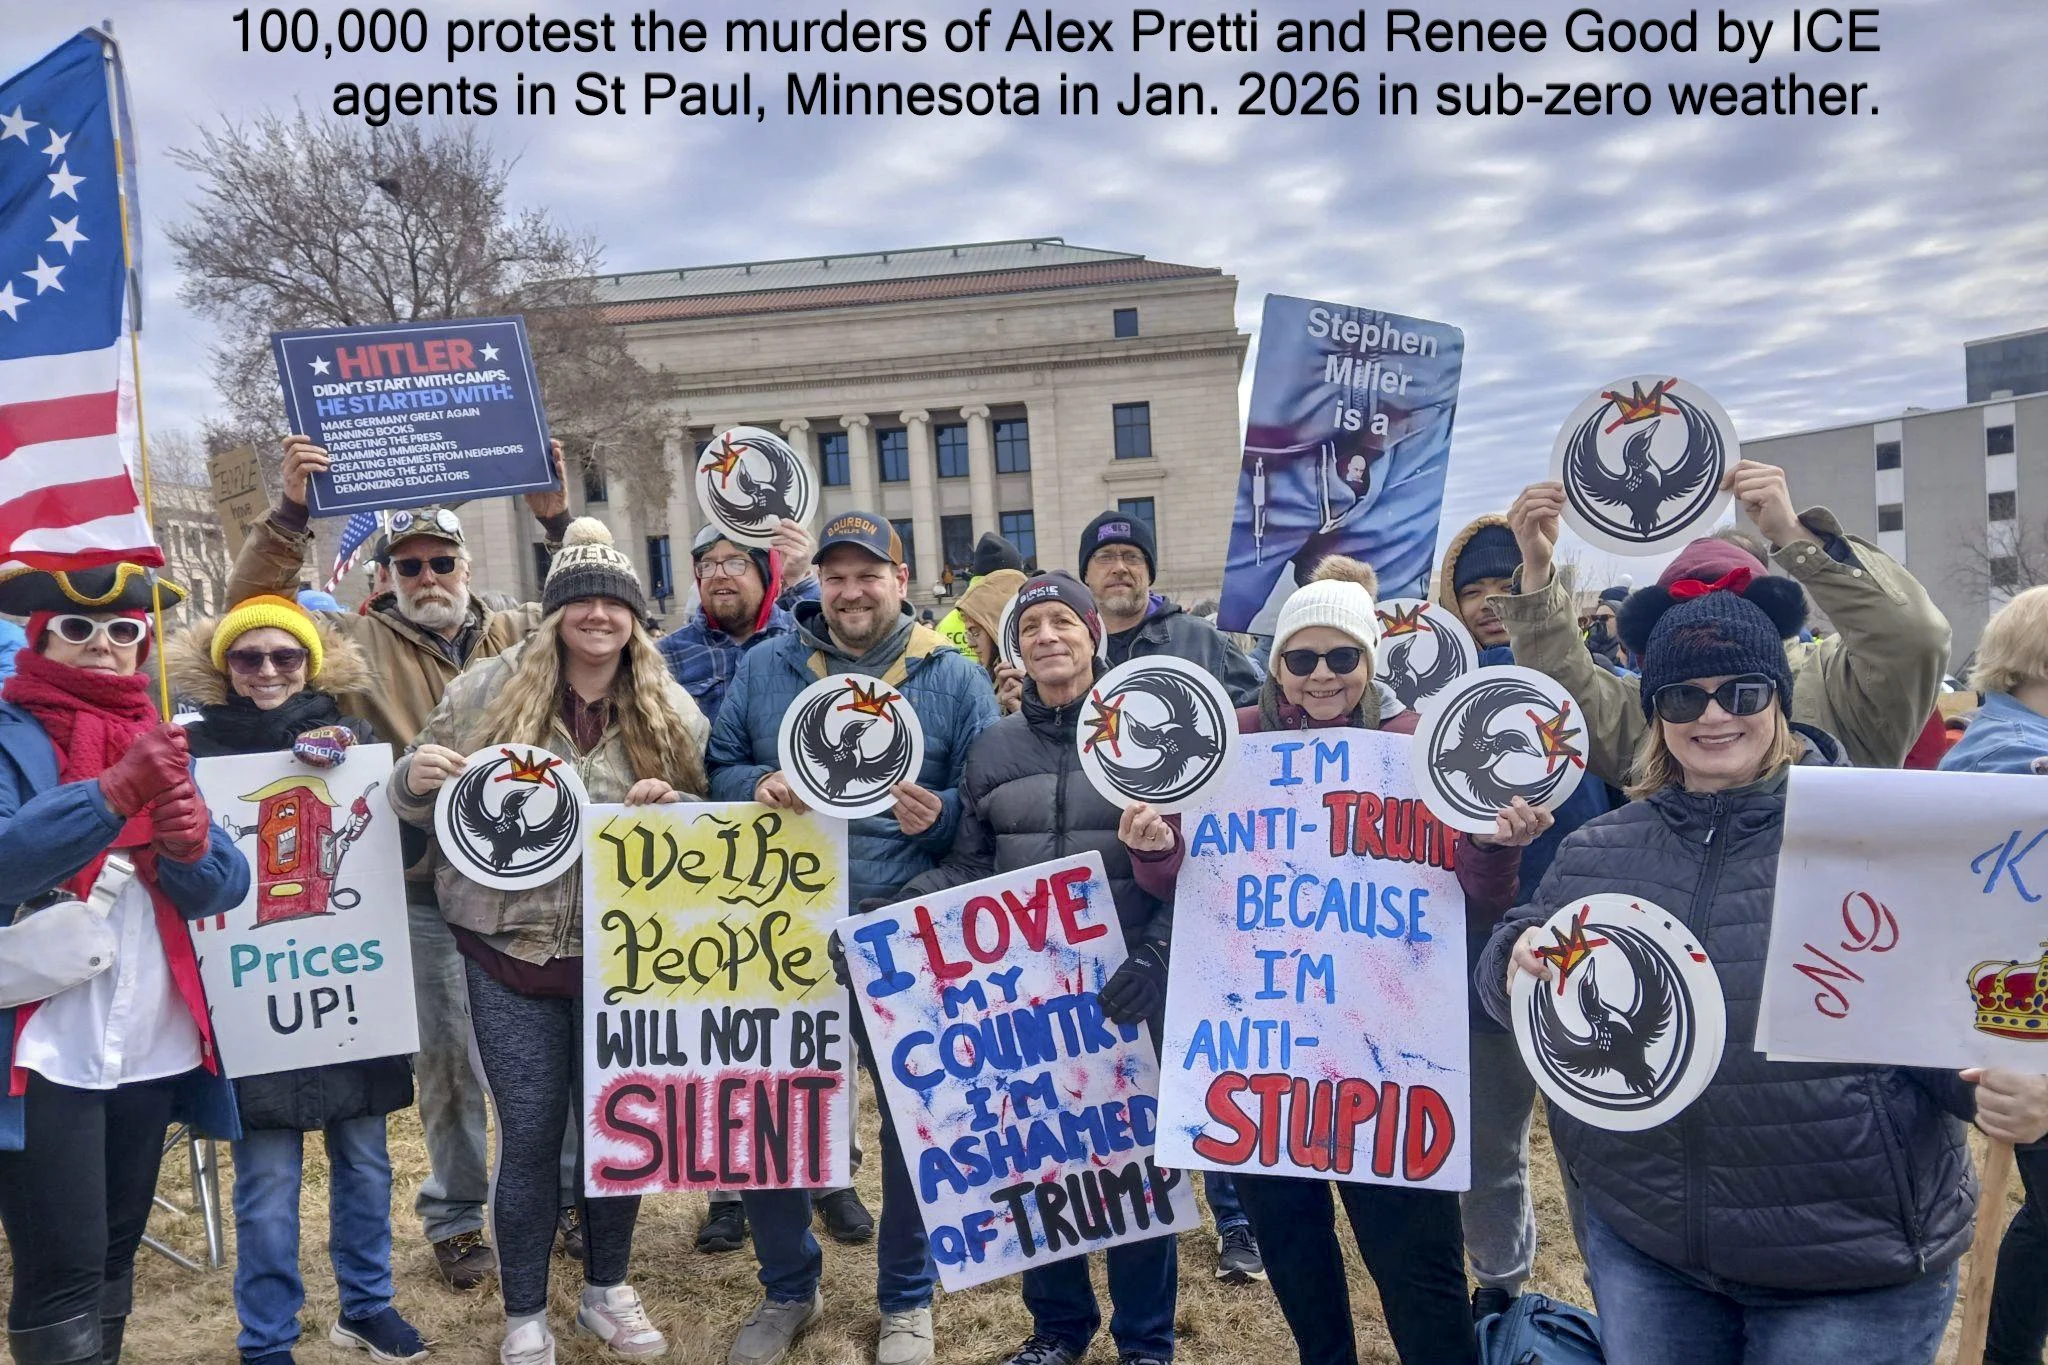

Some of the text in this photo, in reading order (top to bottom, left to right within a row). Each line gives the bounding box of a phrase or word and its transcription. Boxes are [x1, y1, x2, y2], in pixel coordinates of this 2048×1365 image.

[1307, 307, 1438, 358] Stephen
[312, 369, 510, 397] DIDN'T START WITH CAMPS.
[336, 339, 477, 379] HITLER
[1324, 354, 1413, 396] Miller
[316, 383, 514, 417] HE STARTED WITH:
[321, 407, 480, 431] MAKE GERMANY GREAT AGAIN
[1333, 401, 1390, 436] is a
[323, 424, 415, 441] BANNING BOOKS
[325, 432, 443, 451] TARGETING THE PRESS
[328, 441, 457, 462] BLAMMING IMMIGRANTS
[330, 445, 524, 473] CREATING ENEMIES FROM NEIGHBORS
[333, 463, 446, 483] DEFUNDING THE ARTS
[335, 471, 470, 494] DEMONIZING EDUCATORS
[827, 517, 878, 537] BOURBON
[1020, 585, 1059, 604] BIRKIE
[1269, 737, 1350, 786] I'M
[599, 815, 719, 897] We
[854, 866, 1108, 998] I LOVE
[1236, 874, 1433, 942] BECAUSE
[230, 938, 384, 988] Prices
[1255, 949, 1336, 1004] I'M
[1793, 890, 1900, 1019] NO
[267, 984, 358, 1035] UP!
[942, 965, 1024, 1019] MY
[596, 1006, 842, 1071] WILL NOT BE
[892, 992, 1139, 1090] COUNTR
[1183, 1017, 1320, 1072] ANTI-
[965, 1071, 1059, 1132] I'M
[1192, 1070, 1456, 1181] STUPID
[601, 1077, 837, 1185] SILENT
[918, 1094, 1158, 1204] ASHAMED
[929, 1155, 1182, 1265] OF TRUMP
